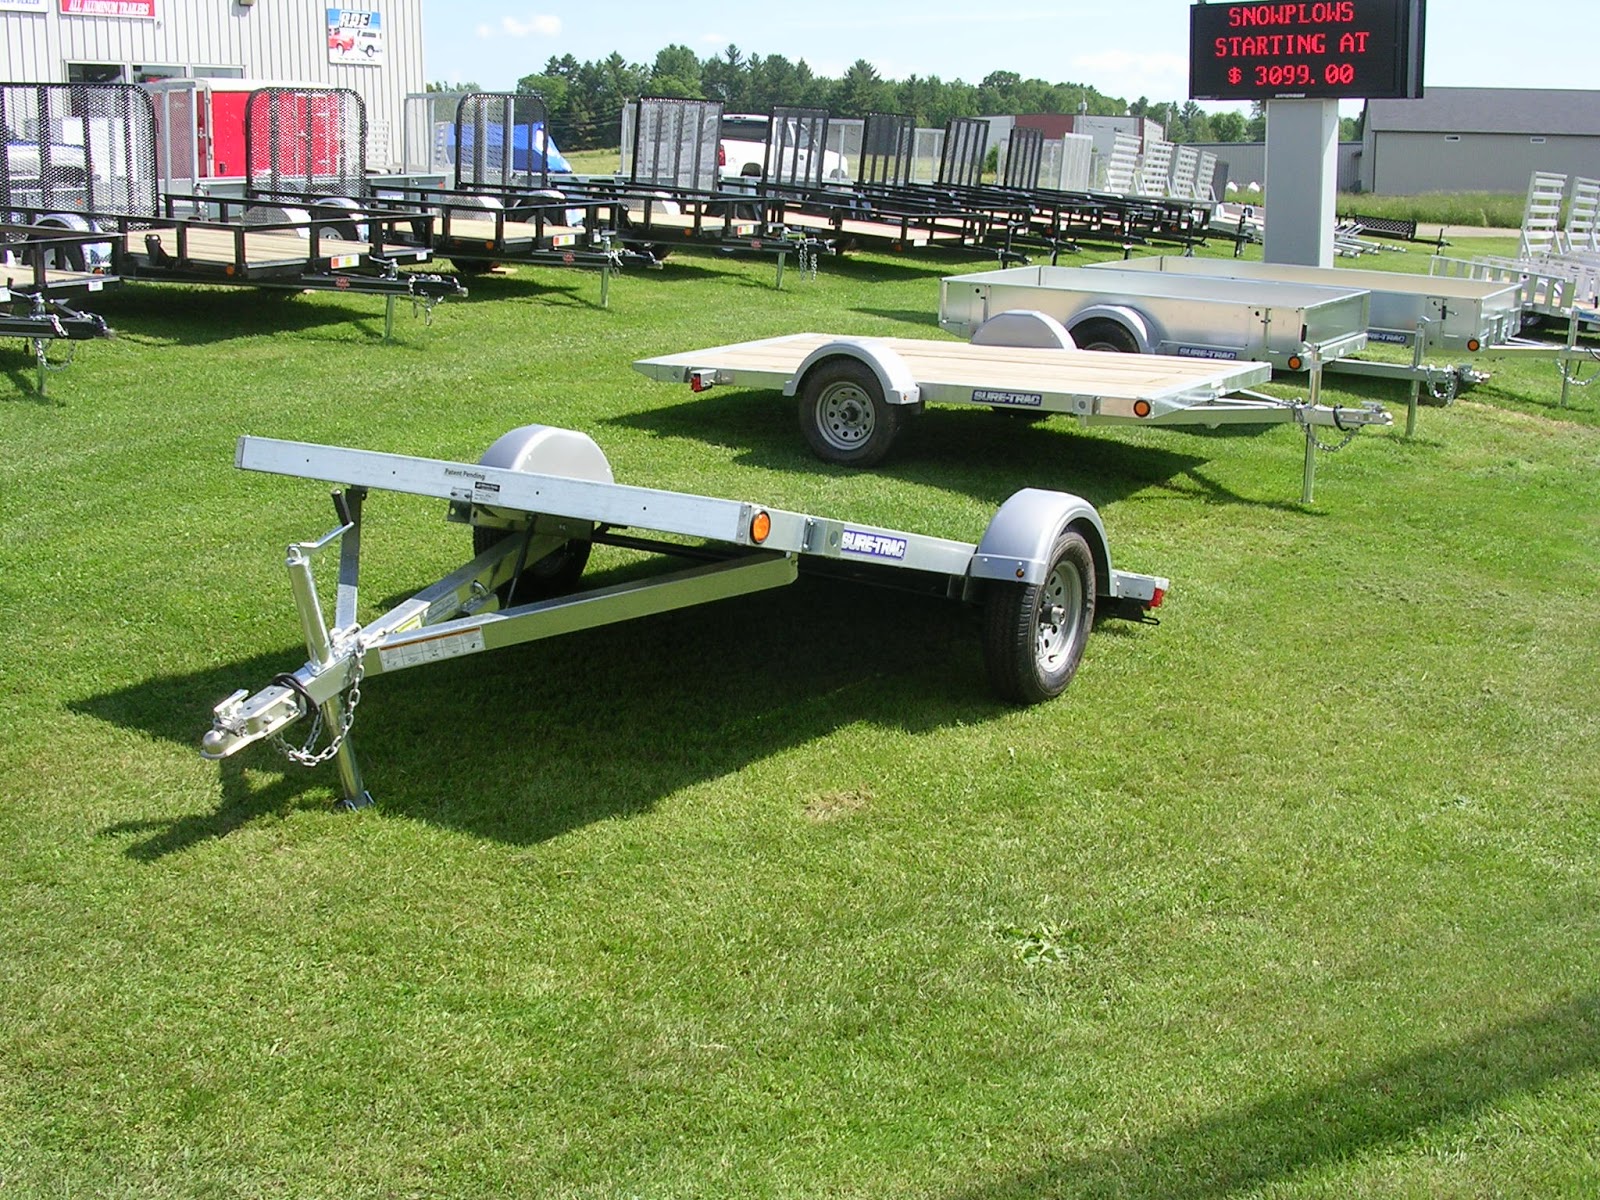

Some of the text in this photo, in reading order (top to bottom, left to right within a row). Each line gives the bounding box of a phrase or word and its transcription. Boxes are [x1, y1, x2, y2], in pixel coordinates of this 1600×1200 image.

[1229, 2, 1354, 27] SNOWPLOWS
[1215, 31, 1370, 57] STARTING AT
[1228, 67, 1242, 84] $
[1179, 347, 1236, 360] SURE-TRAC
[973, 390, 1041, 406] SURE-TRAC
[445, 468, 486, 481] Patent Pending
[841, 531, 905, 557] SURE-TRAC
